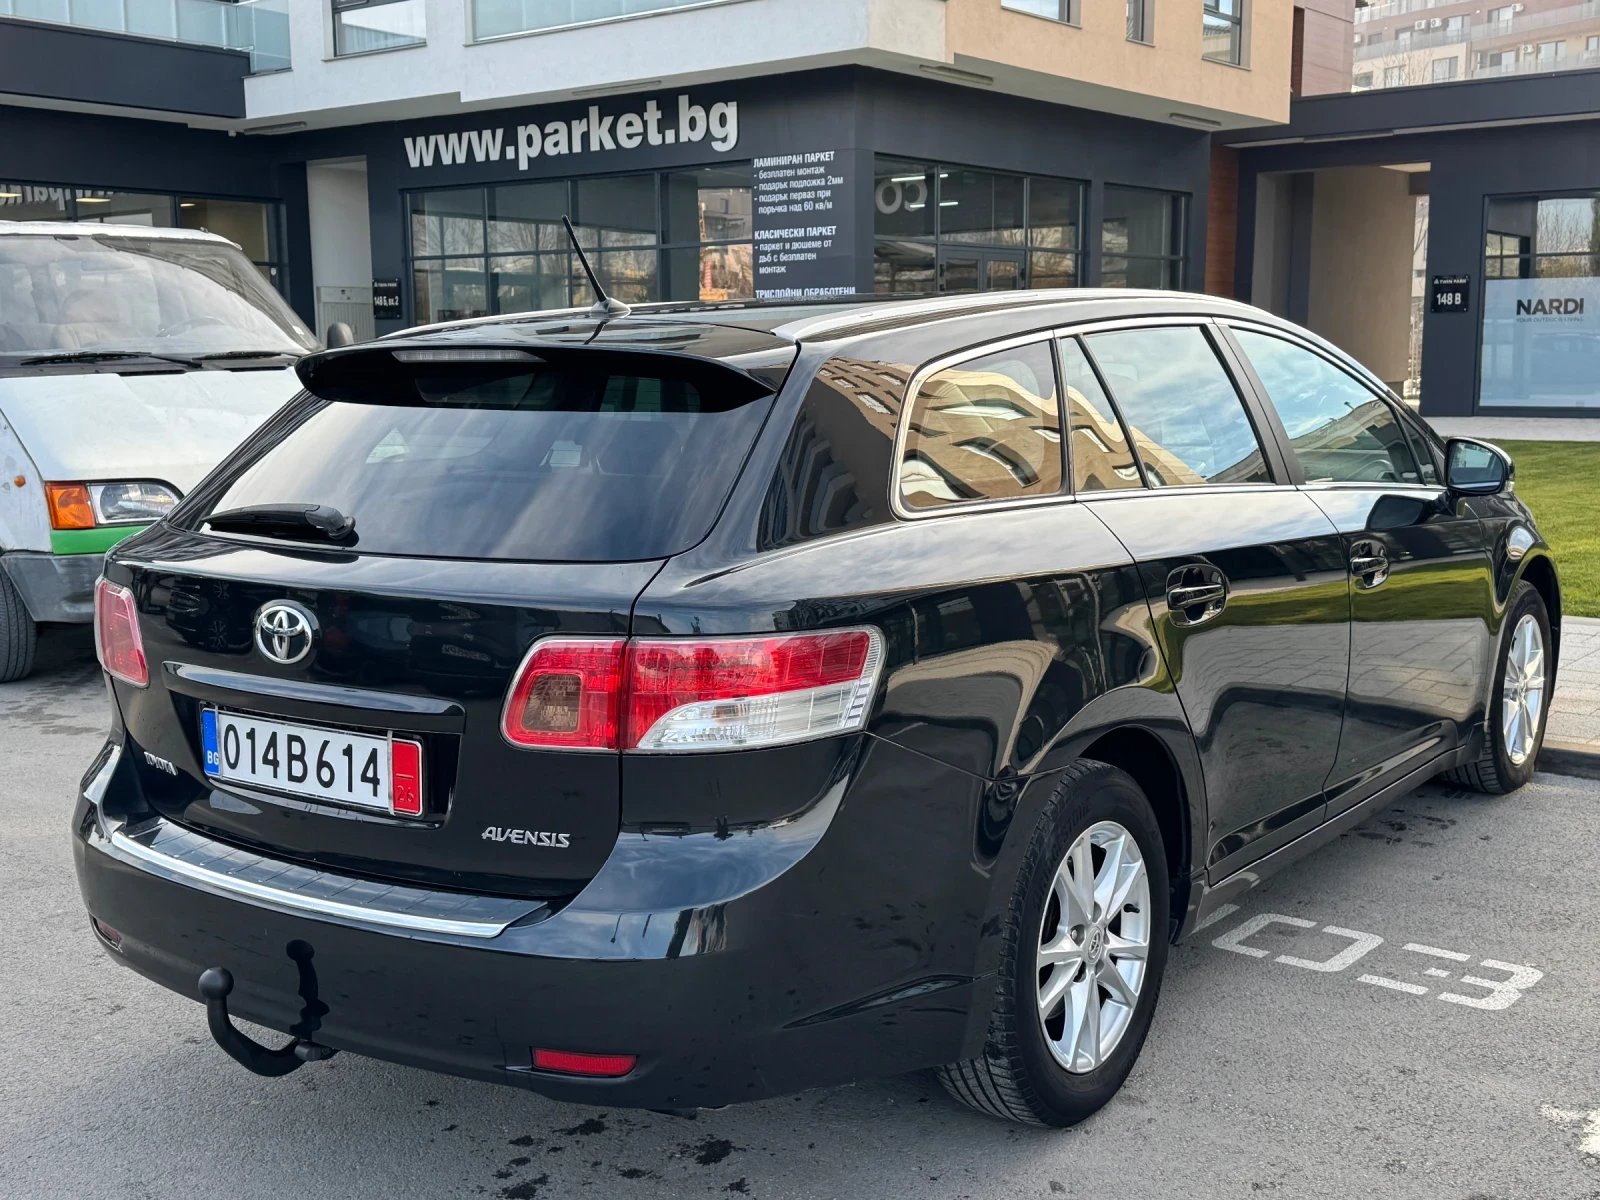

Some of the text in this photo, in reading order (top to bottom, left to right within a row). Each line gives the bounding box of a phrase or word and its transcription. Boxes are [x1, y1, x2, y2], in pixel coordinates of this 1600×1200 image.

[404, 94, 738, 171] www.parket.bg
[753, 151, 835, 168] ЛАМИНИРАН ПАРКЕТ
[758, 166, 826, 179] безплатен монтаж
[789, 178, 826, 189] подложка
[827, 175, 844, 185] 2мм
[789, 190, 816, 200] перваз
[817, 189, 831, 200] при
[789, 203, 803, 212] над
[804, 201, 814, 211] 60
[815, 200, 833, 210] кв/м
[754, 225, 837, 240] КЛАСИЧЕСКИ ПАРКЕТ
[759, 239, 833, 252] паркет и дюшеме от
[773, 254, 778, 262] с
[779, 252, 817, 262] безплатен
[759, 265, 786, 274] монтаж
[755, 287, 803, 298] ТРИСЛОЙНИ
[1436, 292, 1453, 305] 148
[1516, 297, 1585, 315] NARDI
[207, 723, 381, 798] BG 014B614
[397, 785, 415, 803] 26
[481, 826, 571, 848] AVENSIS
